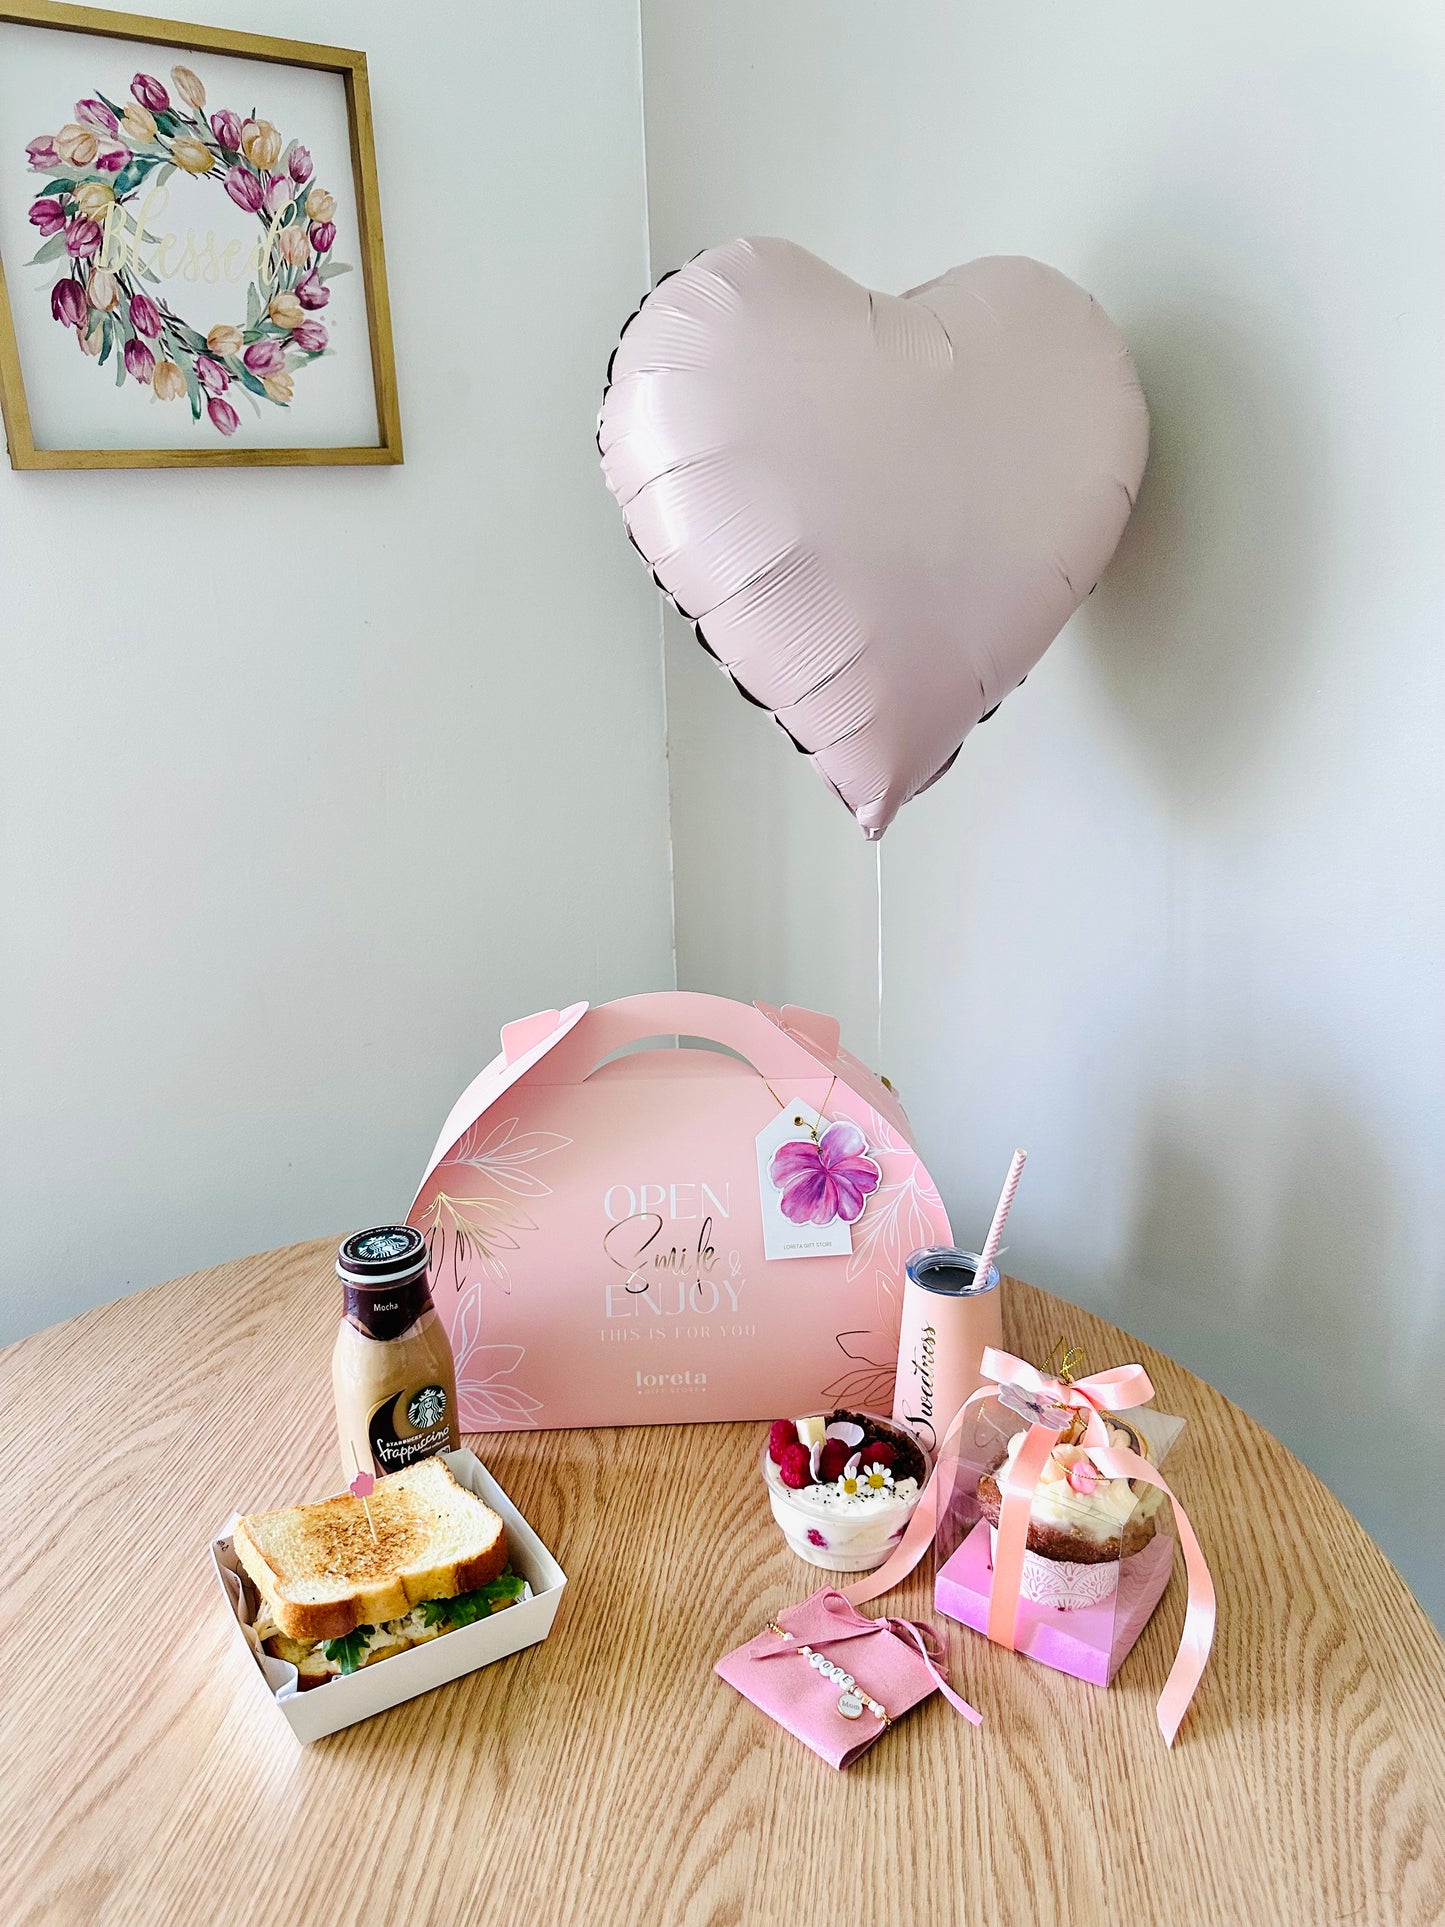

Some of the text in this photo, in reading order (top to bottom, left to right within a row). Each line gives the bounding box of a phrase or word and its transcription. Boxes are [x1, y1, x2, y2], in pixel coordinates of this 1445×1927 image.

[86, 185, 298, 286] Blessed
[603, 1182, 731, 1222] OPEN
[602, 1212, 743, 1296] Smile &
[373, 1301, 399, 1312] Mocha
[604, 1279, 747, 1319] ENJOY
[601, 1324, 757, 1342] THIS IS FOR YOU
[635, 1370, 707, 1388] loreta
[902, 1320, 937, 1453] Sweetness
[376, 1425, 451, 1464] frappuccino
[386, 1433, 424, 1448] STARBUCKS
[812, 1654, 853, 1685] LOVE
[841, 1700, 861, 1711] Mom
